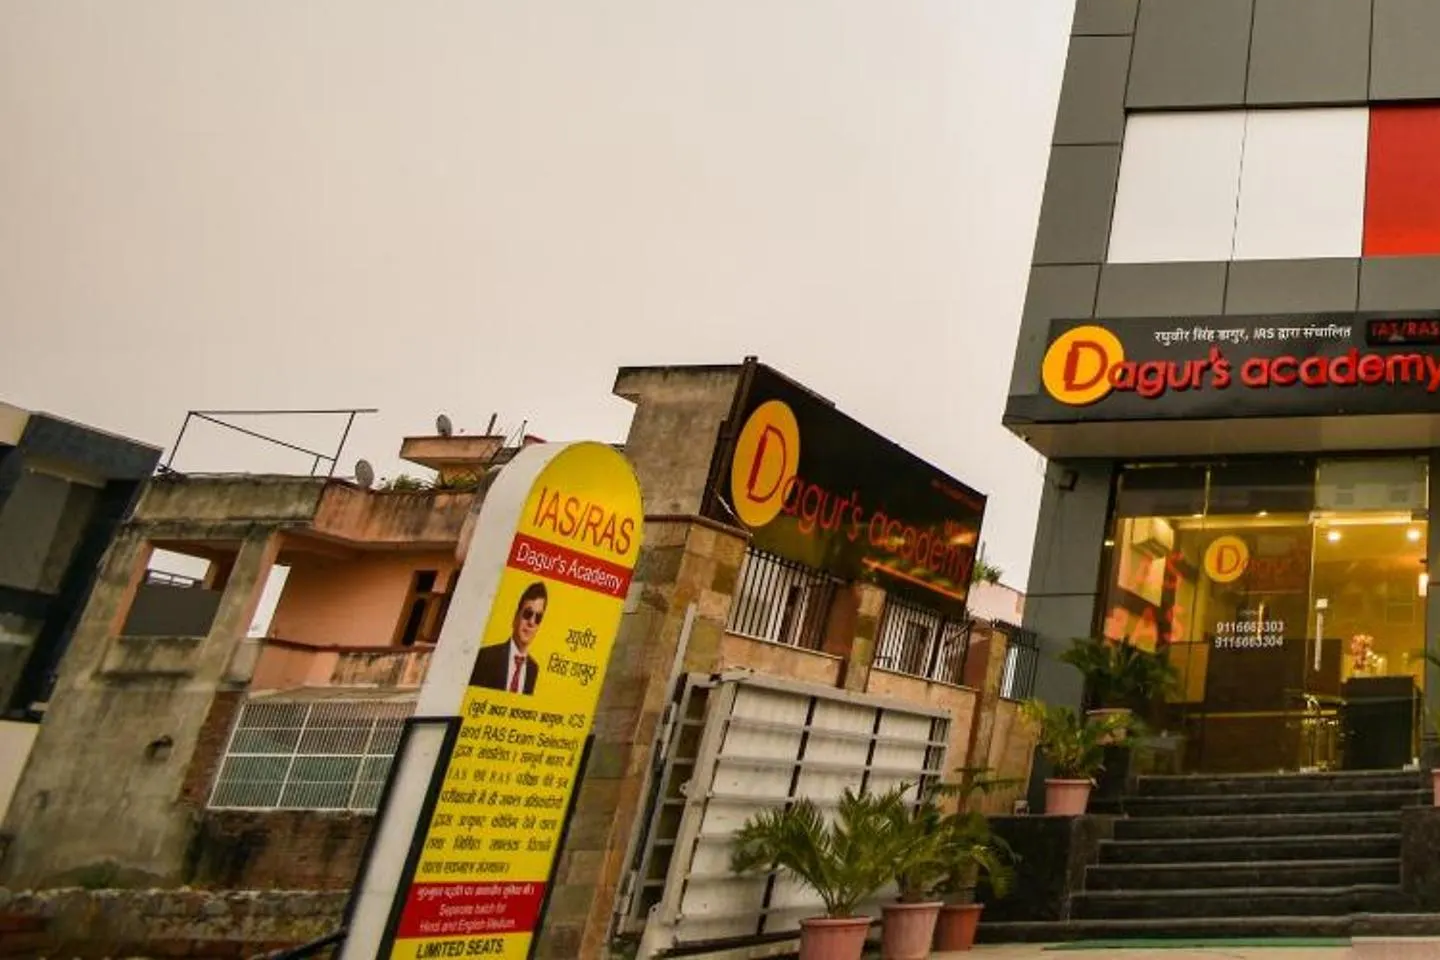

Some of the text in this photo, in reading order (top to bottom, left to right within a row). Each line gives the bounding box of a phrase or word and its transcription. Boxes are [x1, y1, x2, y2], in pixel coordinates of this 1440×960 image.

[1302, 325, 1352, 340] संचालित
[1063, 341, 1231, 399] Dagur's
[532, 487, 635, 556] IAS/RAS
[868, 510, 973, 583] academy
[515, 542, 624, 595] Dagur's Academy
[416, 940, 466, 959] LIMITED
